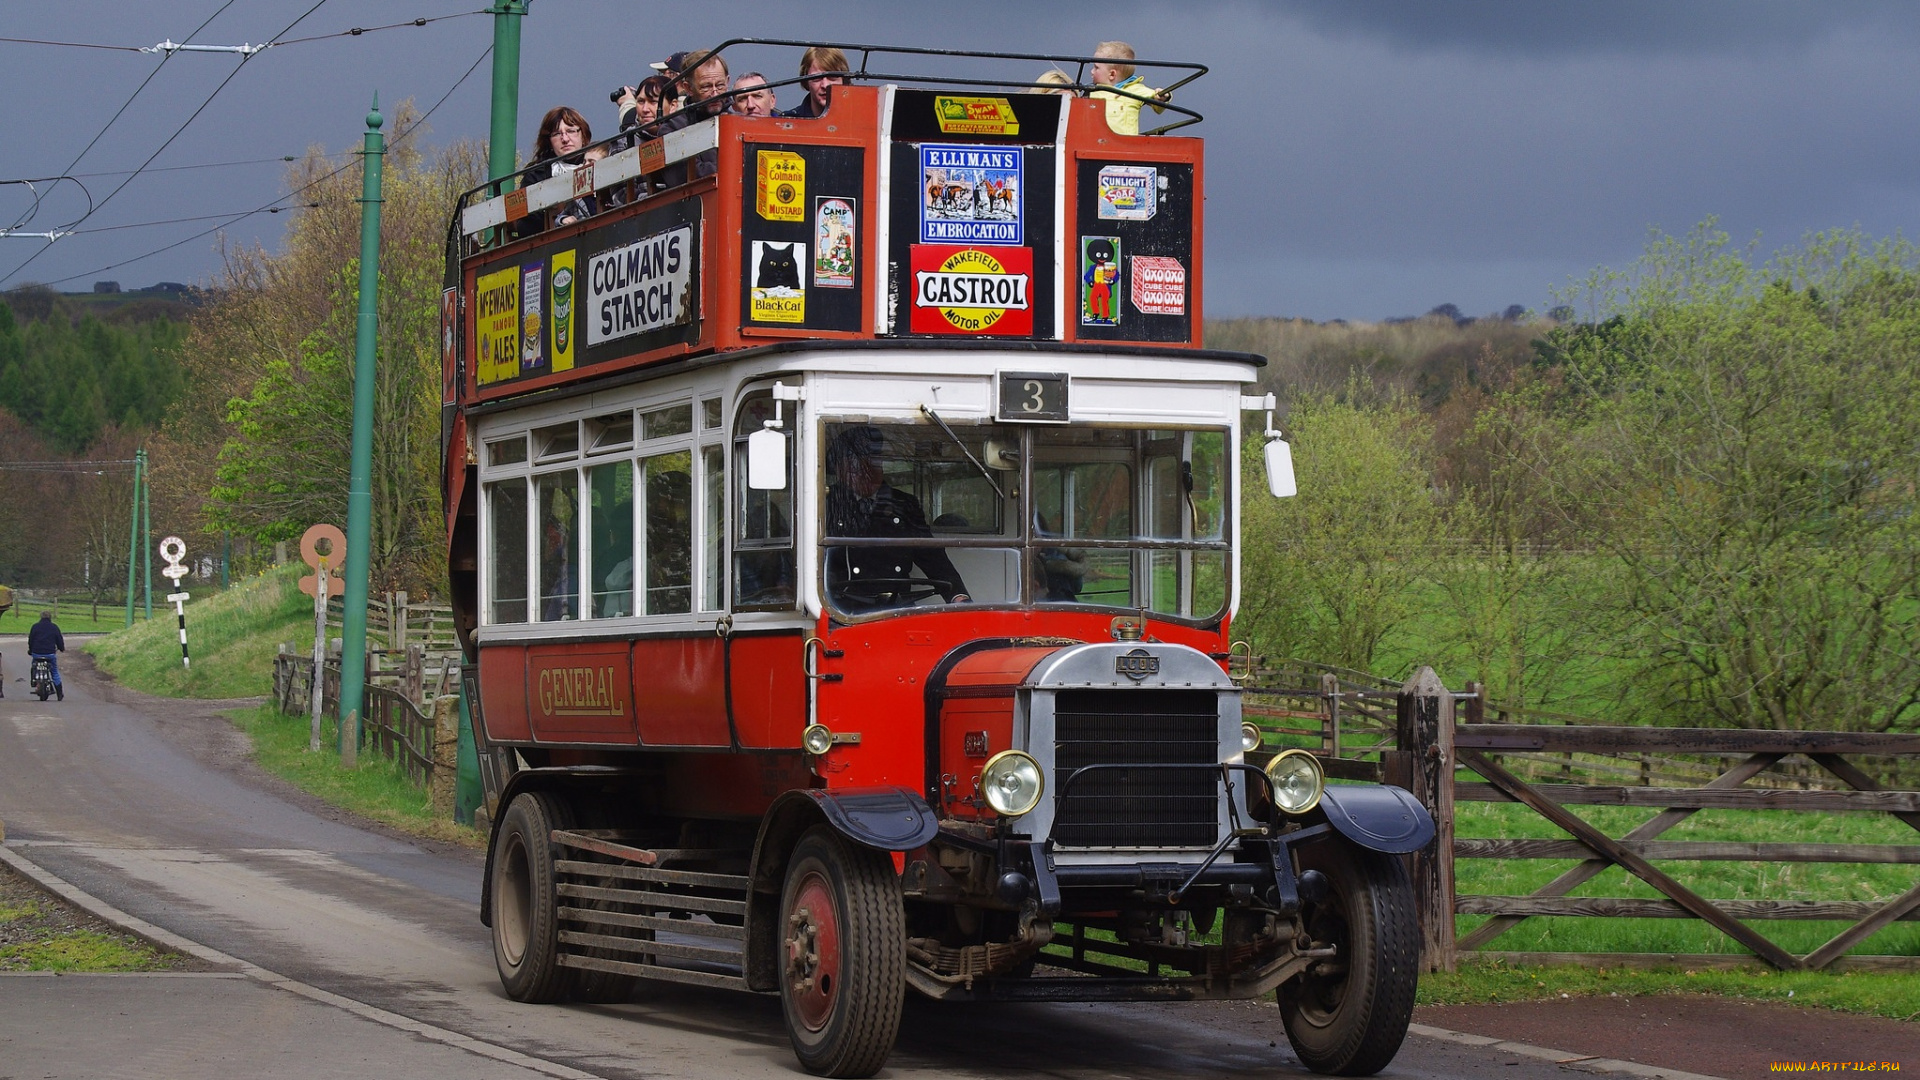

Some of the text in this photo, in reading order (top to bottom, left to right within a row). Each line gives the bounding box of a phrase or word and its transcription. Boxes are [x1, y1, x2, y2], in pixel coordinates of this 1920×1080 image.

[966, 103, 995, 115] SWAN
[929, 151, 1014, 168] ELLIMAN'S
[769, 169, 803, 182] Colman's
[1102, 176, 1146, 191] SUNLIGHT
[1108, 188, 1134, 201] SOAP
[769, 203, 803, 216] MUSTARD
[927, 222, 1016, 239] EMBROCATION
[593, 233, 681, 296] COLMAN'S
[944, 251, 1000, 273] WAKEFIELD
[1144, 268, 1184, 283] OXO OXO
[922, 276, 1024, 305] CASTROL
[1143, 291, 1183, 305] OXO OXO
[600, 281, 673, 336] STARCH
[755, 299, 801, 312] Black Cat
[493, 315, 515, 332] FAMOUS
[944, 309, 1001, 329] MOTOR OIL
[493, 334, 515, 366] ALES
[1022, 379, 1044, 412] 3
[539, 666, 624, 716] GENERAL
